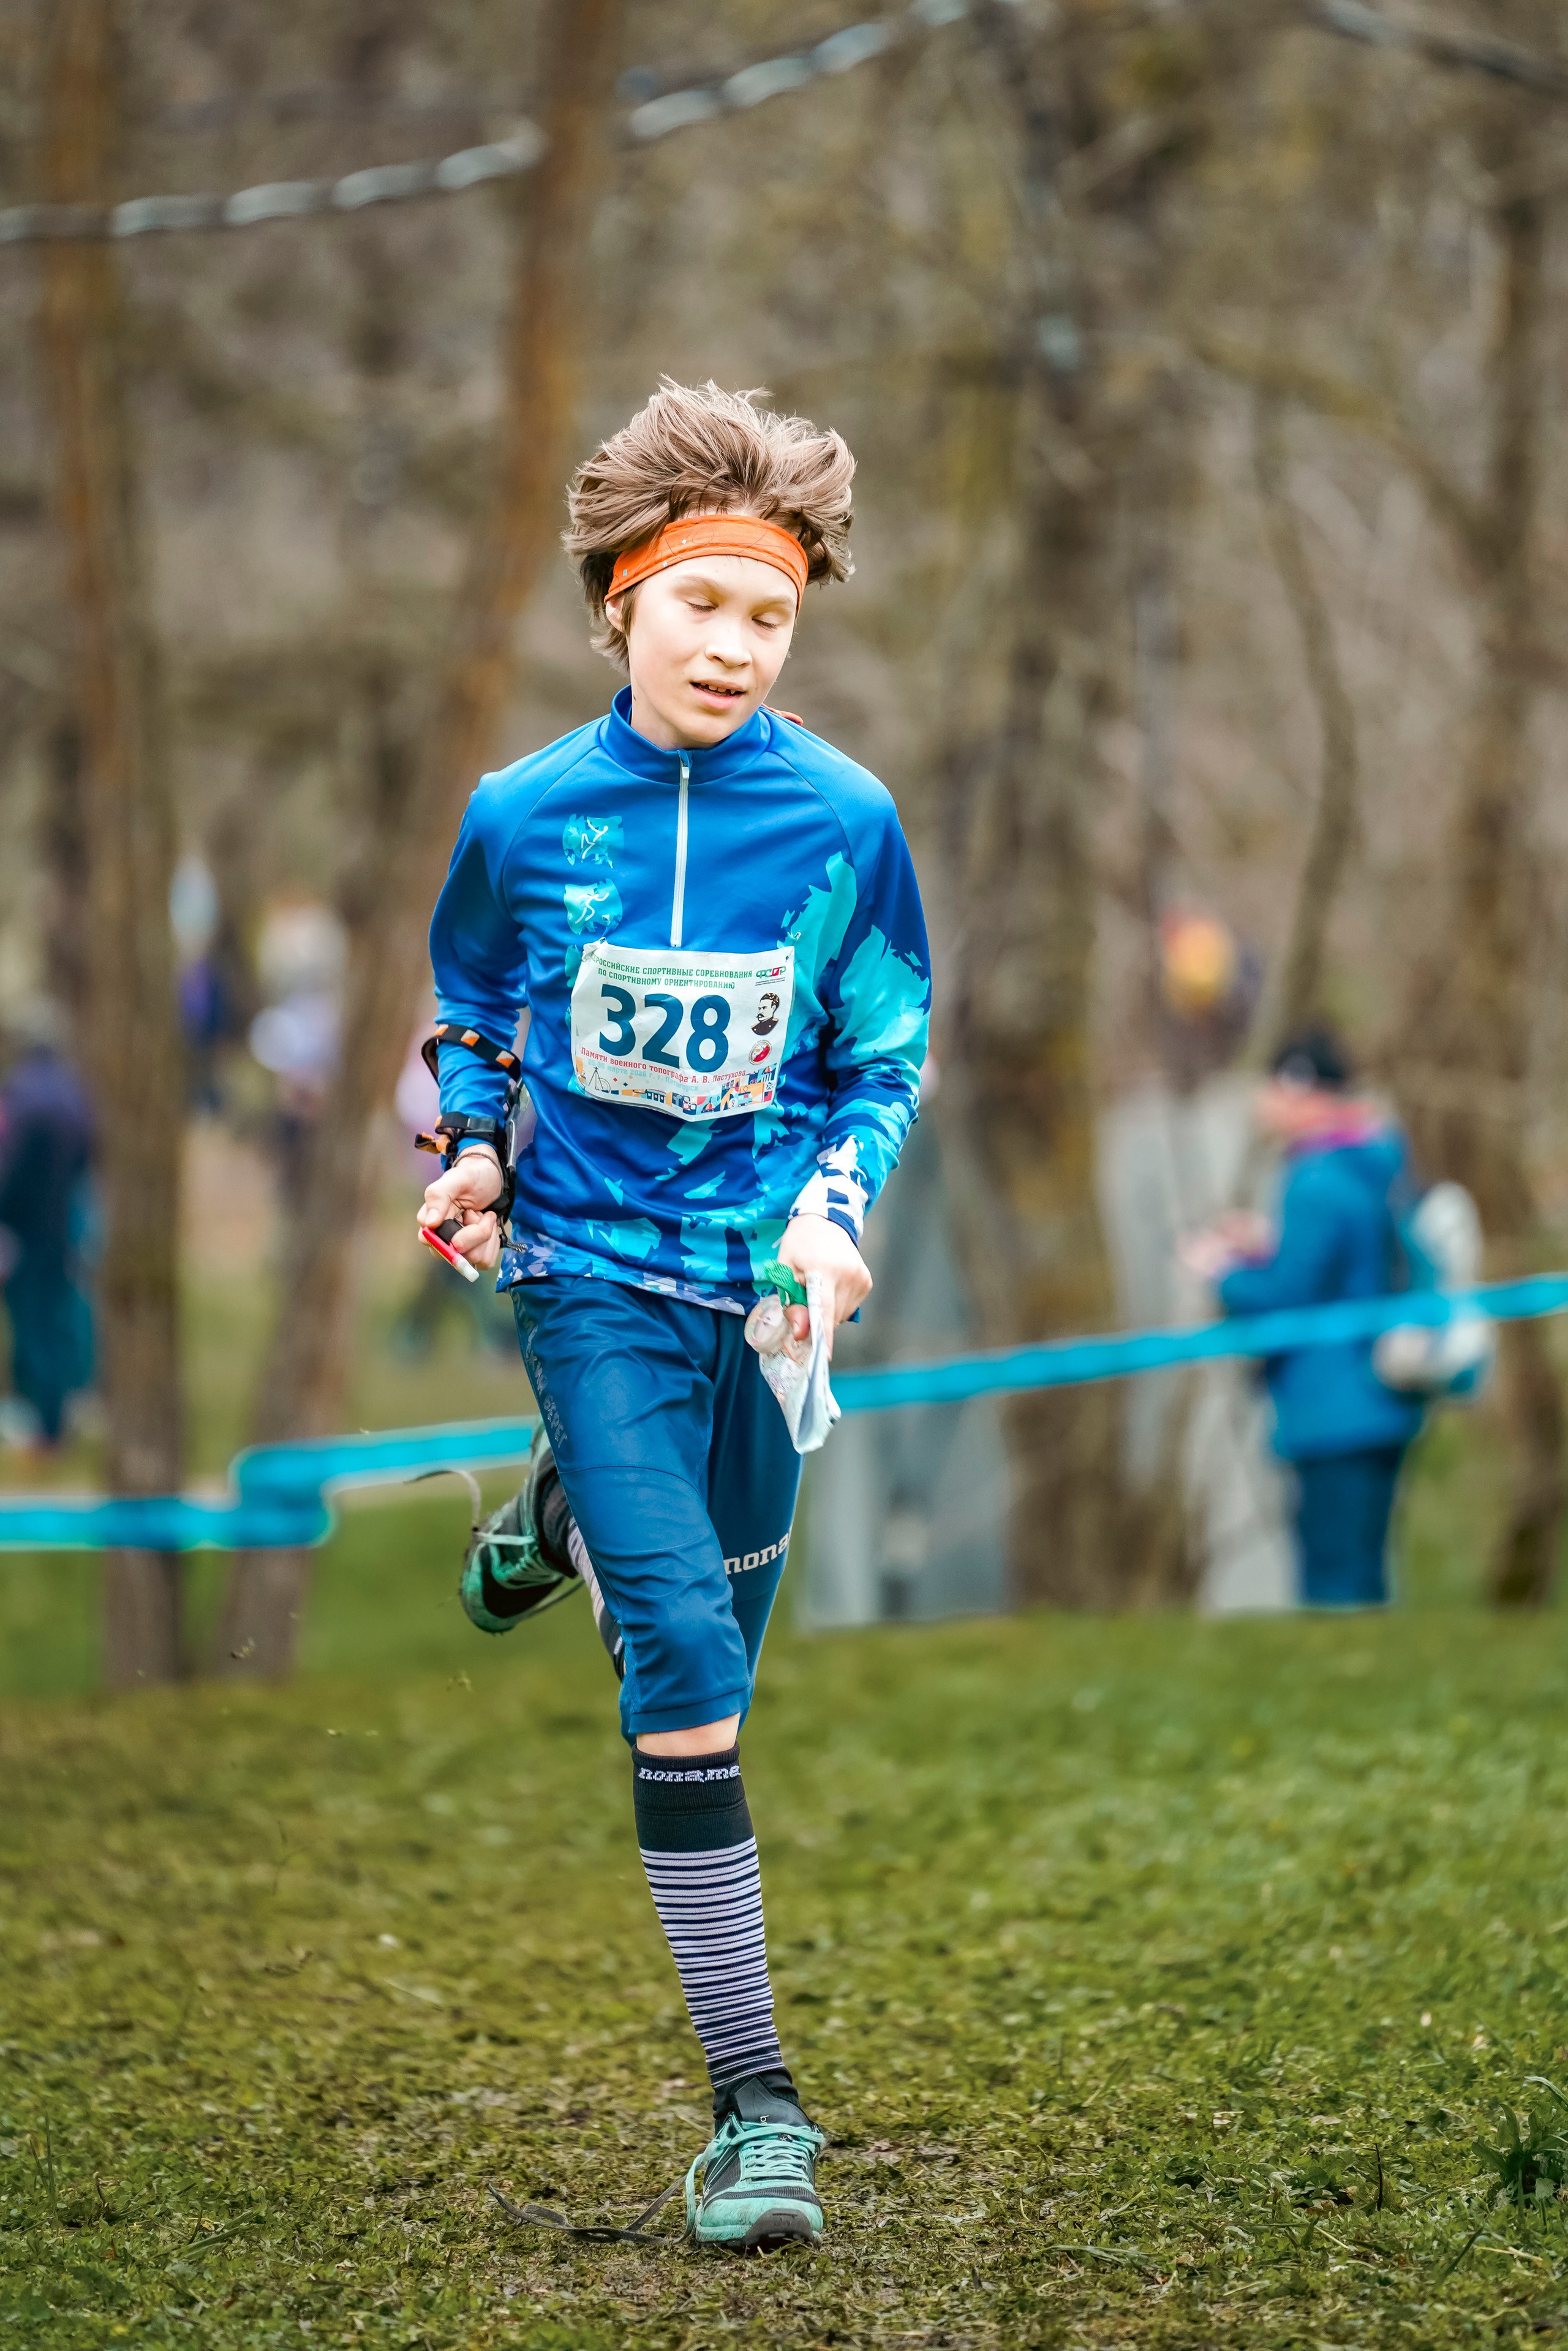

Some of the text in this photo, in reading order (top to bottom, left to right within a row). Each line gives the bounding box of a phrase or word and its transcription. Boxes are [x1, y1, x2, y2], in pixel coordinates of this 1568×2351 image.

[590, 953, 752, 978] СЕРОССИЙСКИЕ СПОРТИВНЫЕ СОРЕВНОВАНИЯ
[598, 968, 735, 989] ПО СПОРТИВНОМУ ОРИЕНТИРОВАНИЮ
[599, 984, 731, 1073] 328
[581, 1047, 608, 1062] Памяти
[610, 1058, 646, 1070] военного
[649, 1065, 688, 1082] топографа
[713, 1070, 746, 1082] Пастухова
[607, 1065, 628, 1074] марта
[665, 1076, 698, 1092] Пятигорск
[638, 1765, 741, 1783] noname
